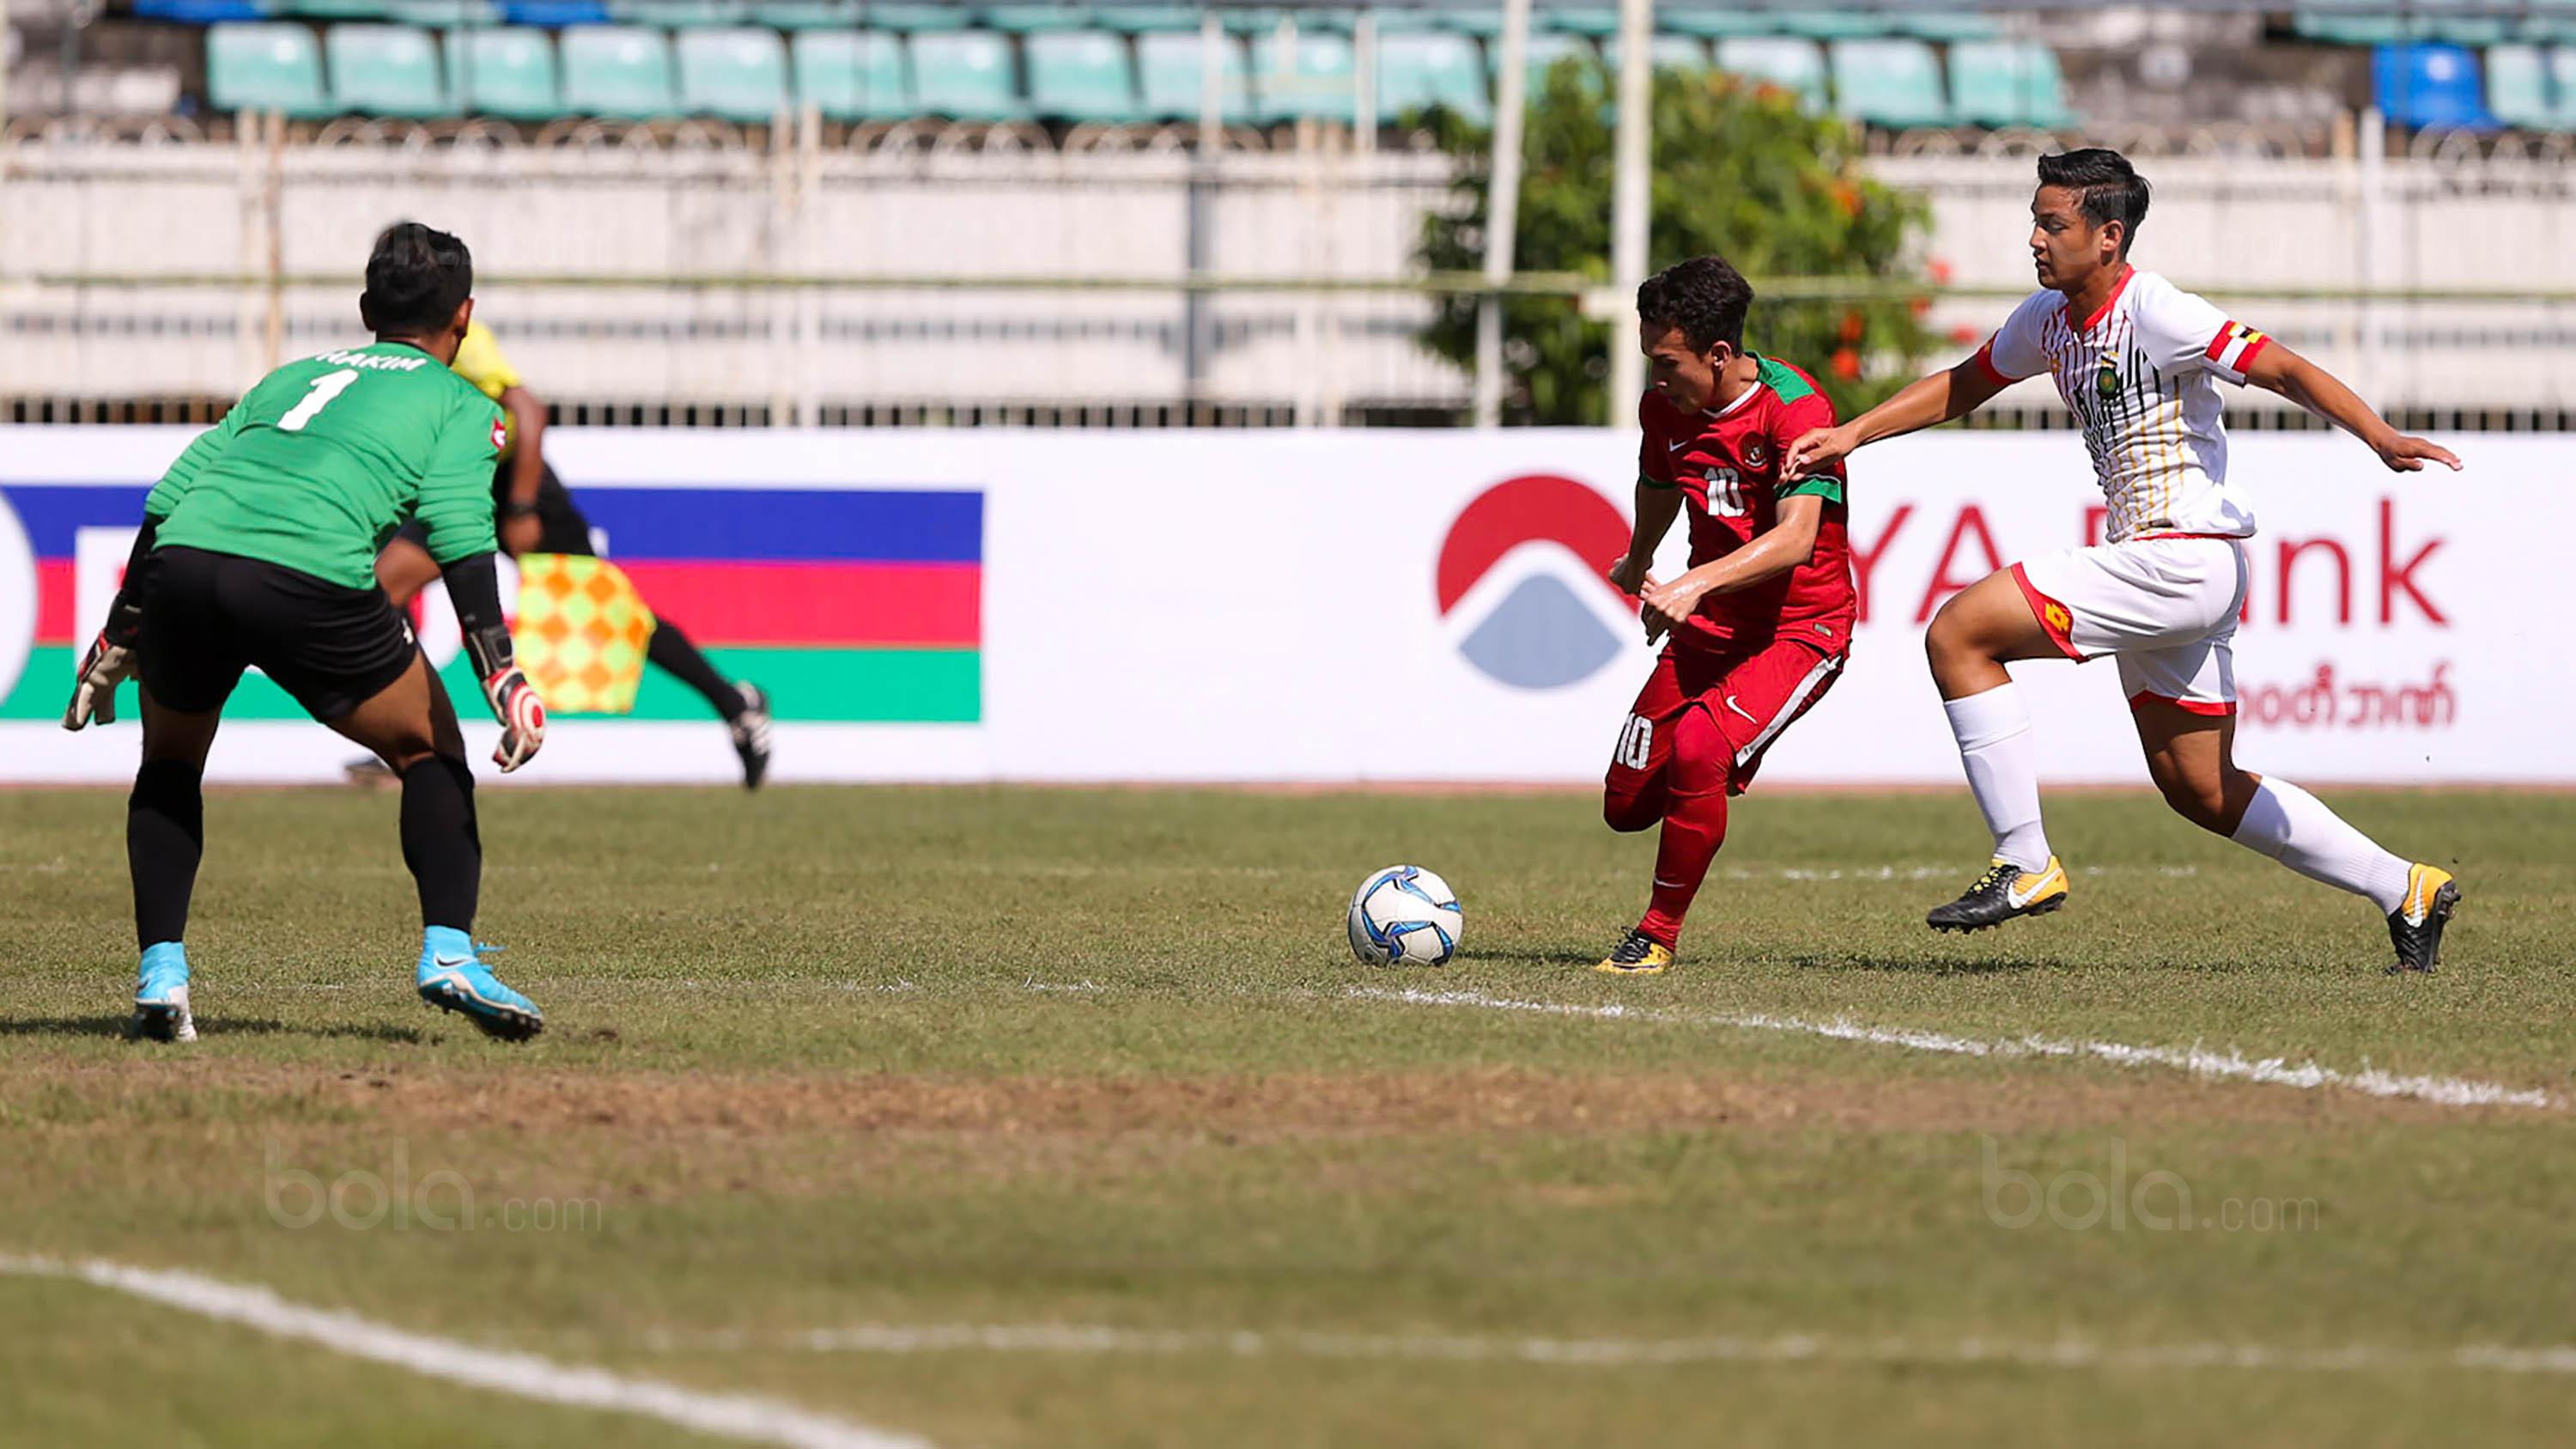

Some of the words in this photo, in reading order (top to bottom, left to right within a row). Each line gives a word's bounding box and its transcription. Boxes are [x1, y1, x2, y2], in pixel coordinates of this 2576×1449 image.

[277, 368, 359, 432] 1
[1704, 467, 1746, 518] 10
[1848, 504, 2003, 624] YA
[2085, 498, 2450, 625] nk
[1616, 712, 1654, 770] 10
